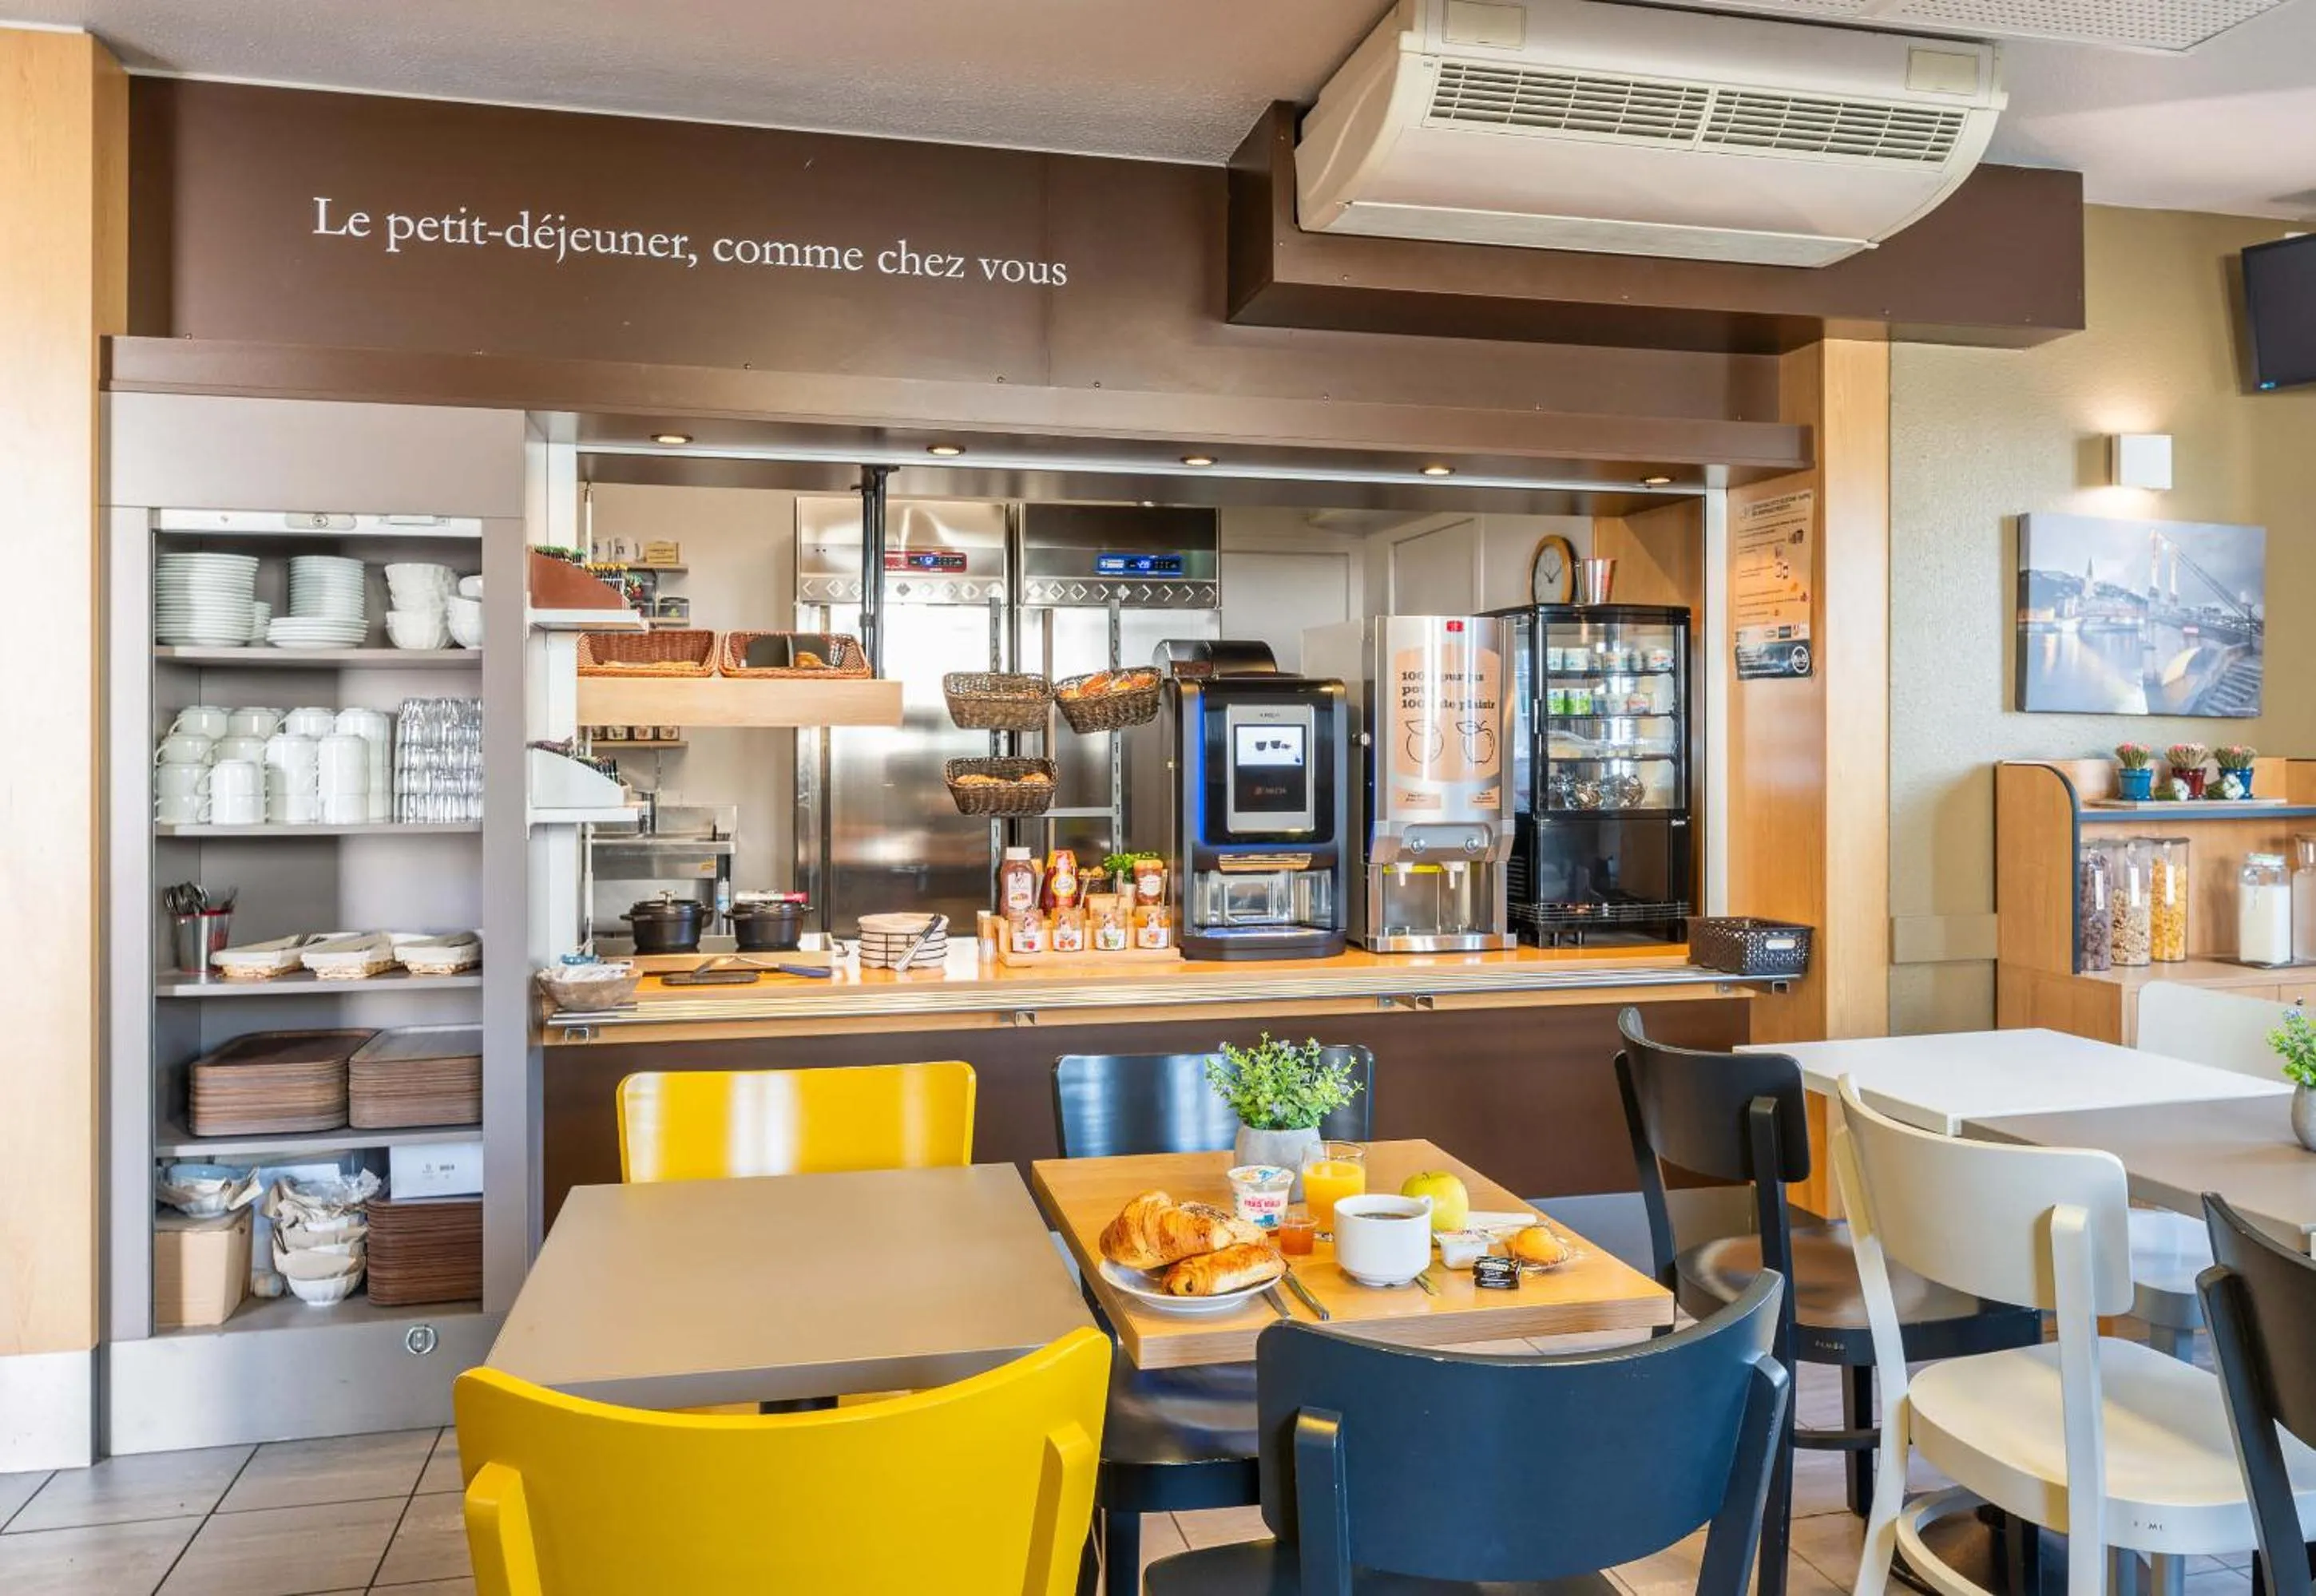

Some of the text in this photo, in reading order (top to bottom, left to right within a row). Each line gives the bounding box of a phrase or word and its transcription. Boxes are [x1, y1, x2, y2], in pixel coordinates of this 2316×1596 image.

[312, 196, 1068, 286] Le petit-déjeuner, comme chez vous
